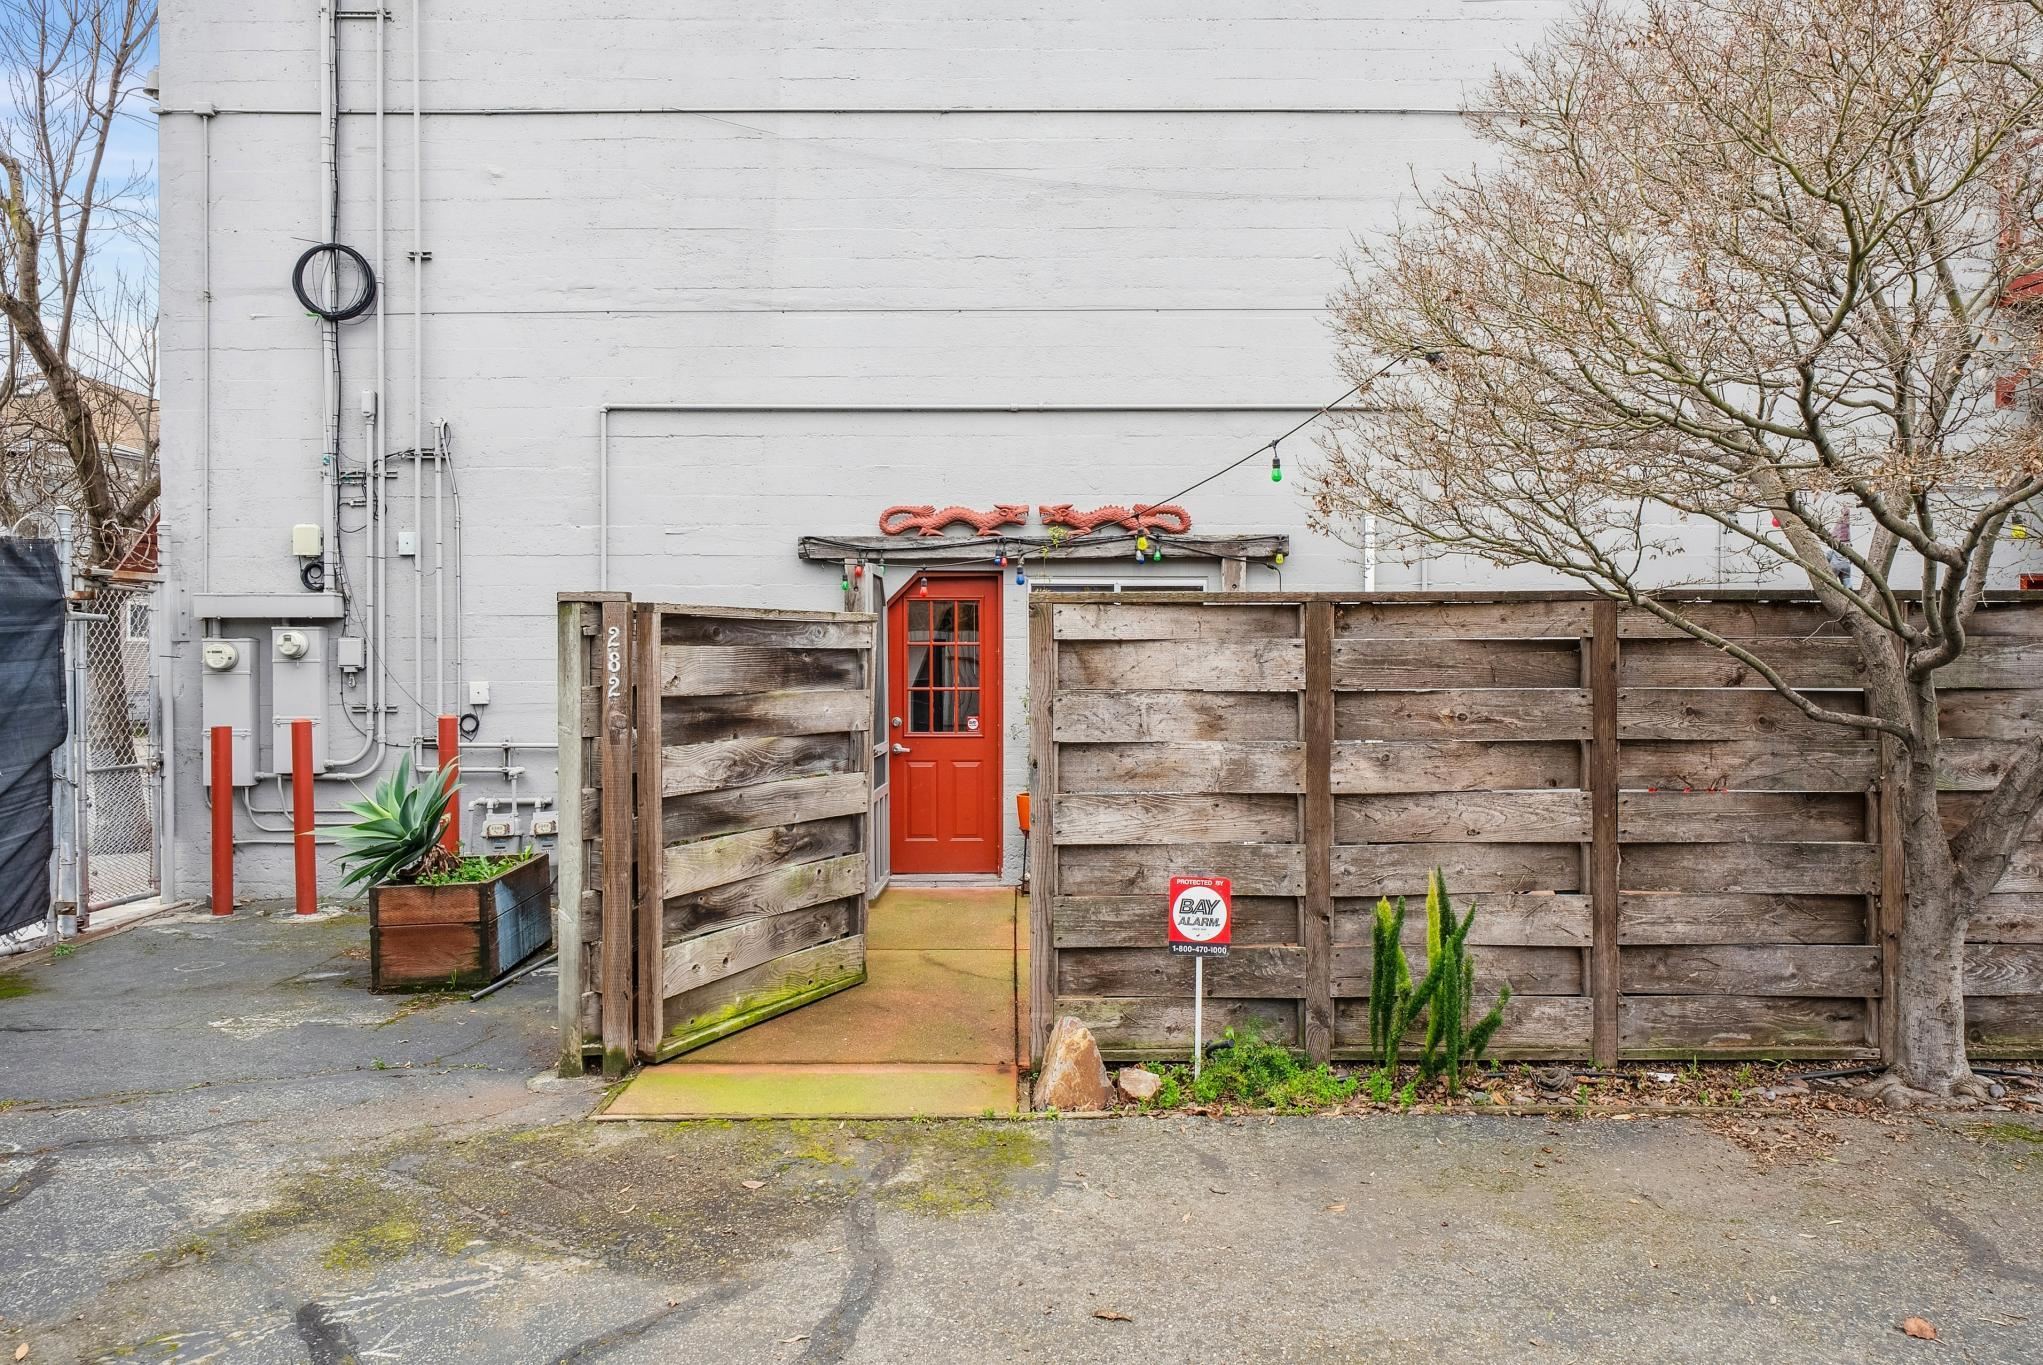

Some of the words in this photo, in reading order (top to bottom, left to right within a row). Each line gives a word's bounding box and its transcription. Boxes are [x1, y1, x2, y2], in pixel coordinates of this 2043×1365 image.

[608, 626, 620, 698] 282
[1179, 898, 1221, 915] BAY
[1178, 916, 1221, 927] ALARM
[1172, 945, 1227, 954] 1-800-470-1000
